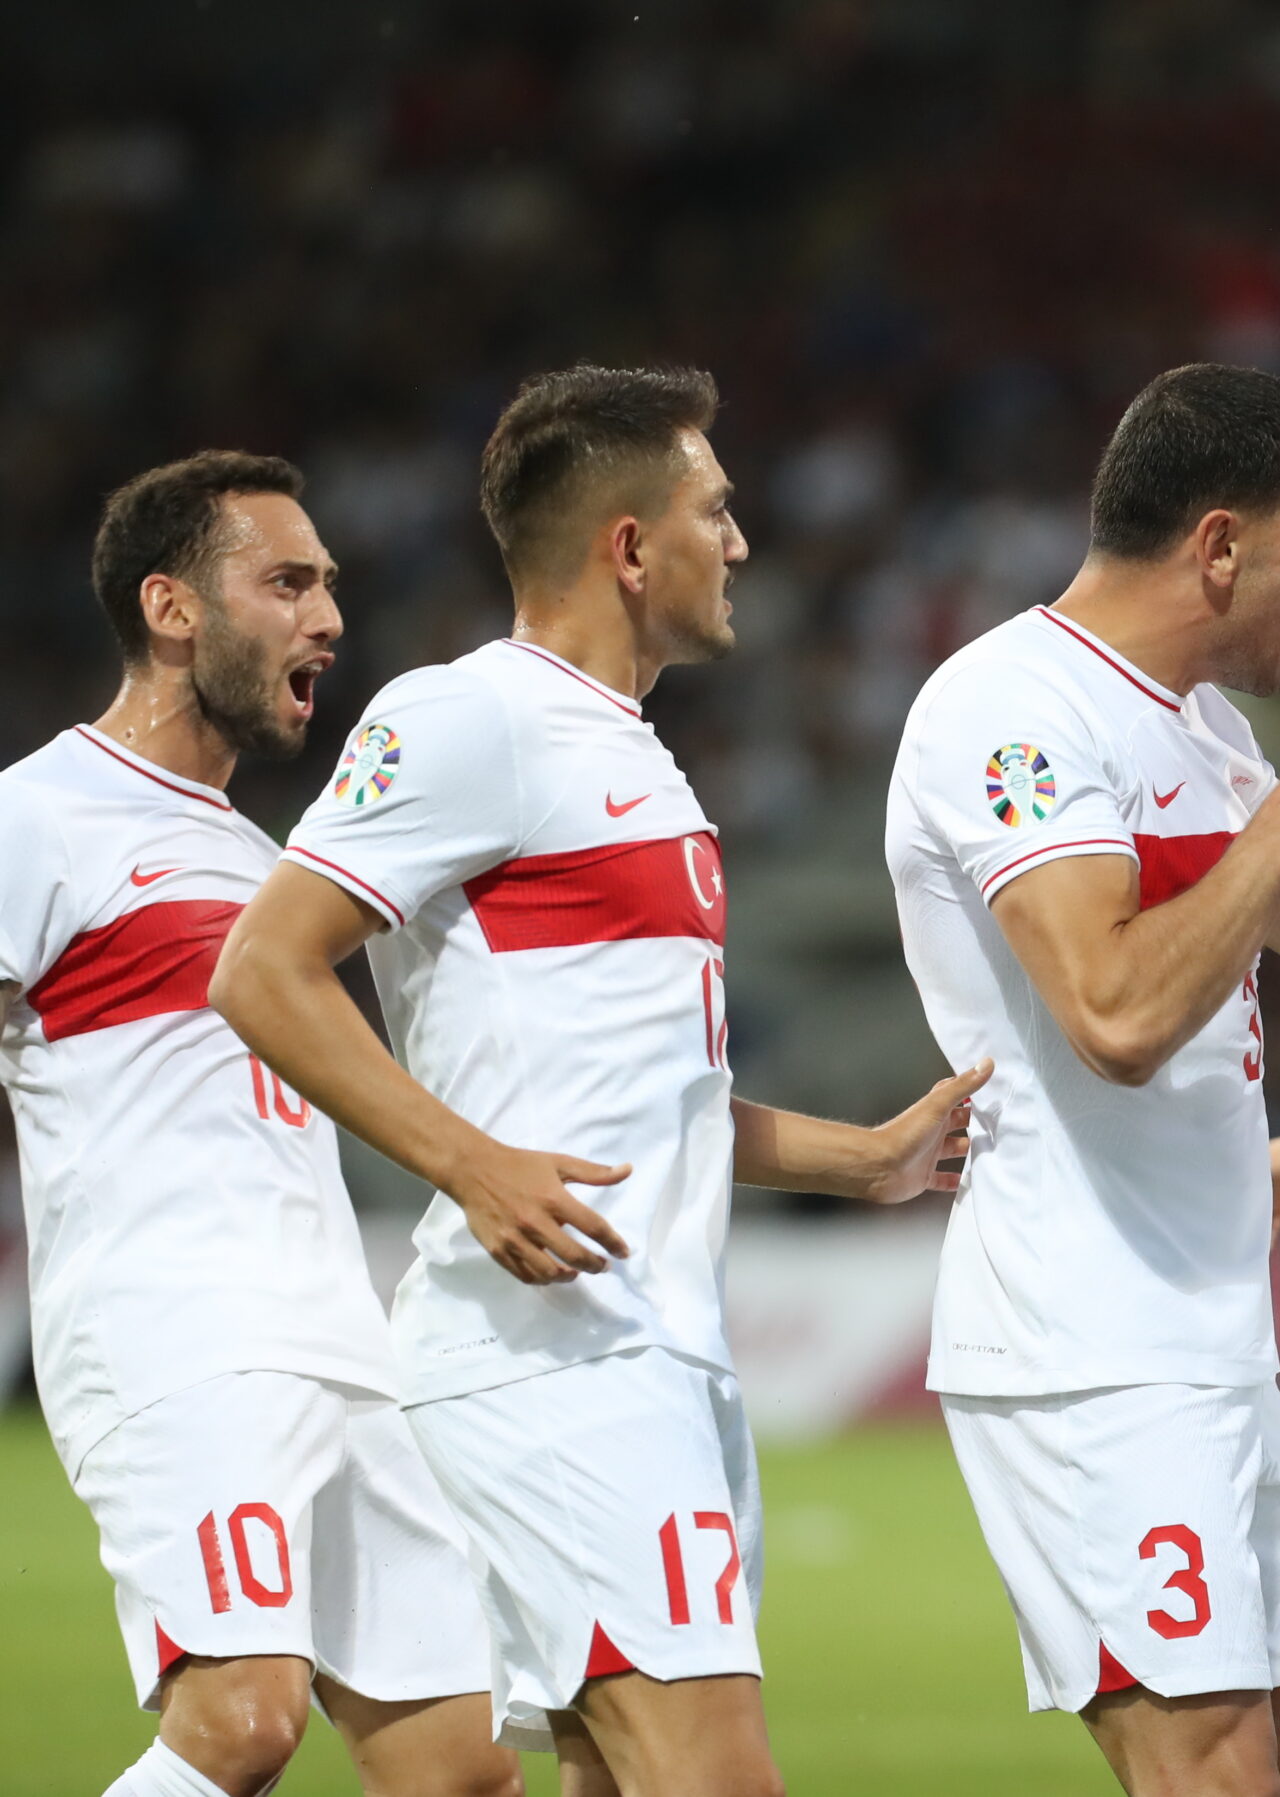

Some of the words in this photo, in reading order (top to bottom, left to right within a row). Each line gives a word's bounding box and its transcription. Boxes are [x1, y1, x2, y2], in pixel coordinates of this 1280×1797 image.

[1242, 969, 1262, 1082] 3
[196, 1502, 294, 1615] 10
[658, 1510, 741, 1626] 17
[1138, 1523, 1212, 1640] 3
